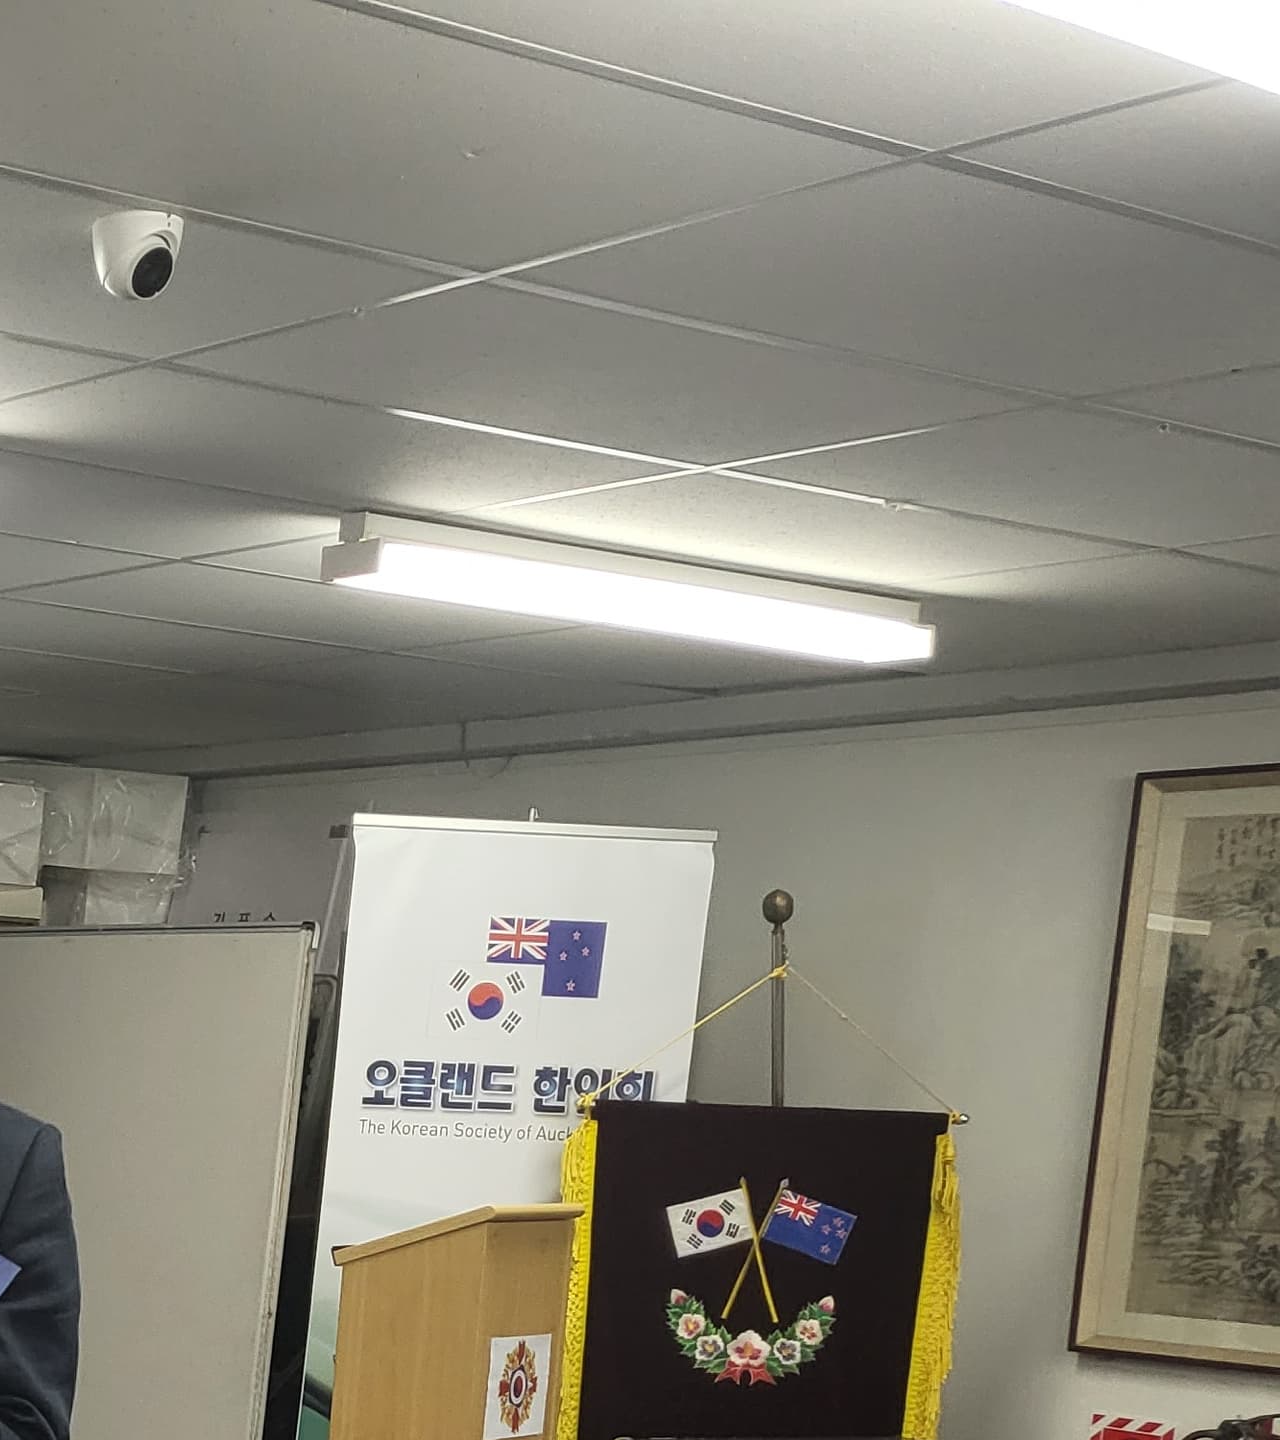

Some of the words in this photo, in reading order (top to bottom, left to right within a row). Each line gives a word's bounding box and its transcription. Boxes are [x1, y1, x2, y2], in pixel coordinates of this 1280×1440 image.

[360, 1059, 518, 1112] 오클랜드
[359, 1119, 387, 1136] The
[390, 1120, 450, 1138] Korean
[453, 1122, 513, 1143] Society
[516, 1124, 533, 1140] of
